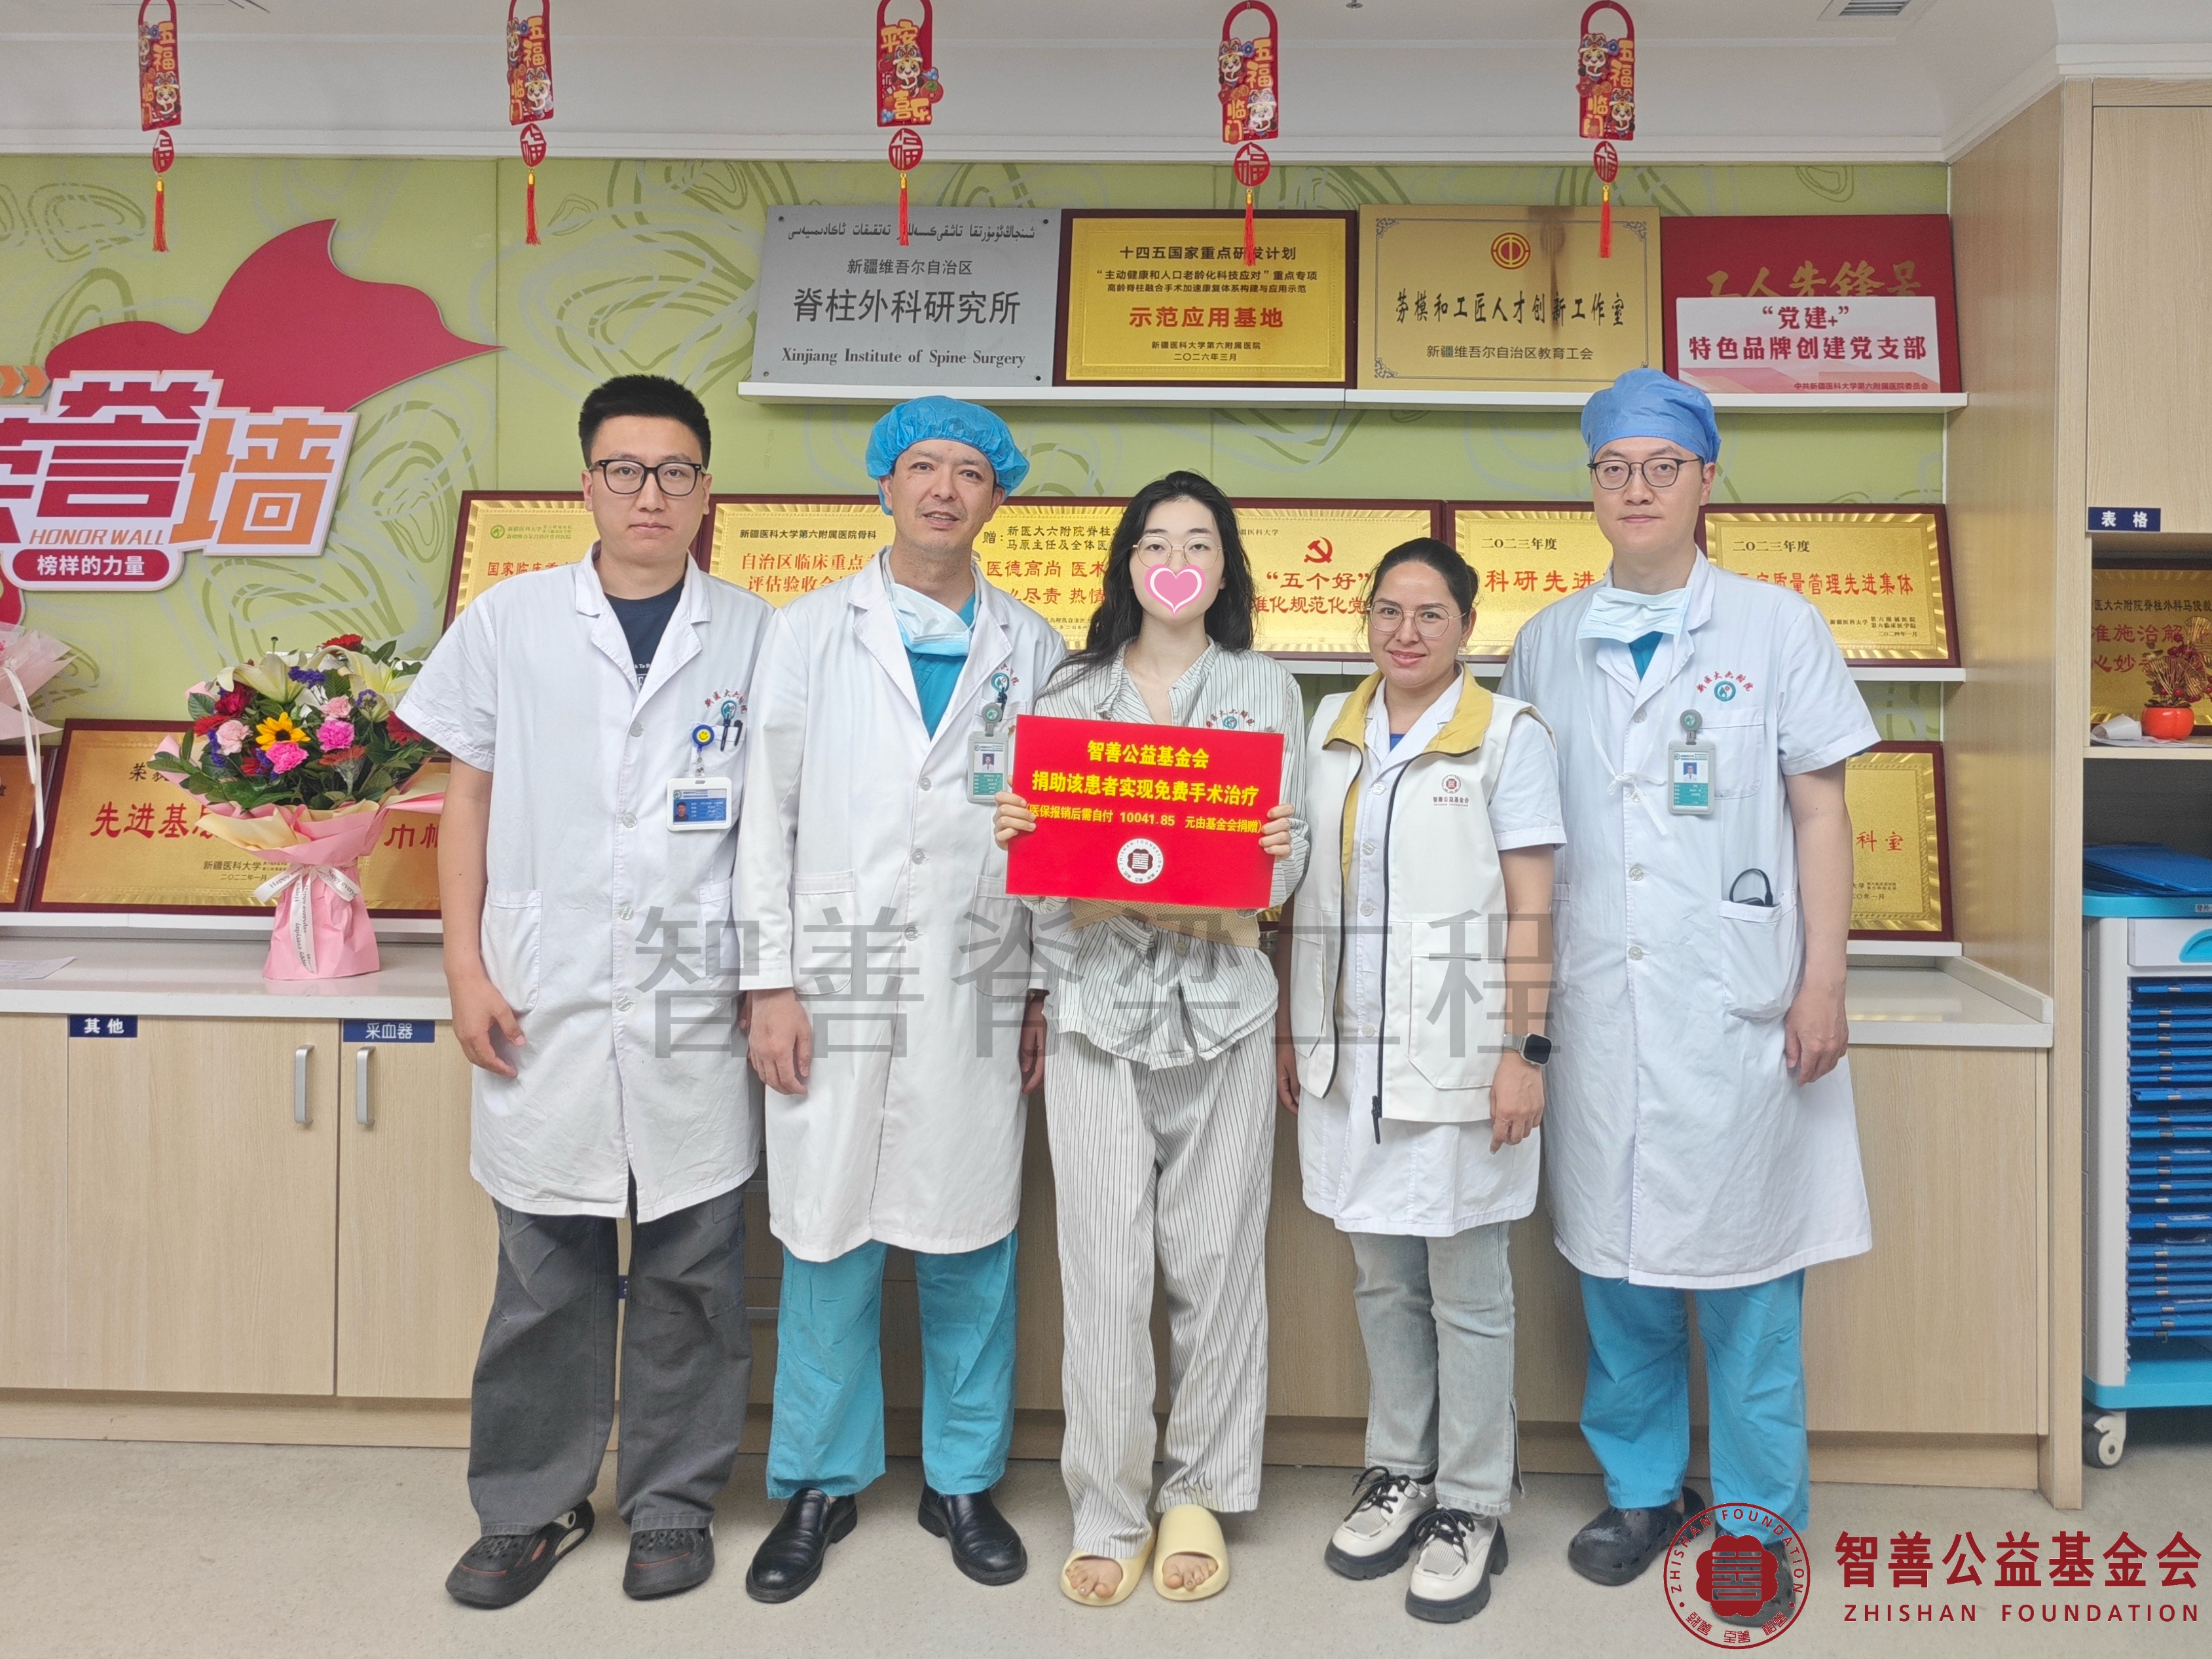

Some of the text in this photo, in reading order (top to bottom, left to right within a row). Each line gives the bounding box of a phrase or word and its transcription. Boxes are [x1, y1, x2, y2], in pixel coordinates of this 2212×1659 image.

[1119, 246, 1297, 261] 十四五国家重点研发计划
[847, 259, 973, 275] 新疆维吾尔自治区
[1107, 283, 1306, 294] 高龄脊柱融合手术加速康复体系构建与应用示范
[793, 287, 1022, 325] 脊柱外科研究所
[1395, 288, 1625, 327] 劳模和工匠人才创新工作室
[1128, 306, 1284, 328] 示范应用基地
[1151, 340, 1261, 350] 新疆医科大学第六附属医院
[1426, 345, 1594, 361] 新疆维吾尔自治区教育工会
[1688, 335, 1926, 360] 特色品牌创建党支部
[781, 348, 1027, 368] Xinjiang Institute of Spine Surgery
[1794, 382, 1928, 391] 中共新疆医科大学第六附属医院委员会
[29, 529, 165, 545] HONOR WALL
[739, 529, 877, 539] 新疆医科大学第六附属医院骨科
[37, 555, 145, 576] 榜样的力量
[741, 553, 874, 571] 自治区临床重点
[747, 575, 849, 592] 评估验收合
[1484, 570, 1606, 593] 科研先进
[1087, 740, 1209, 769] 智善公益基金会
[1031, 770, 1260, 807] 捐助该患者实现免费手术治疗
[203, 860, 262, 871] 新疆医科大学
[84, 1017, 124, 1034] 其他
[365, 1023, 413, 1040] 采血器
